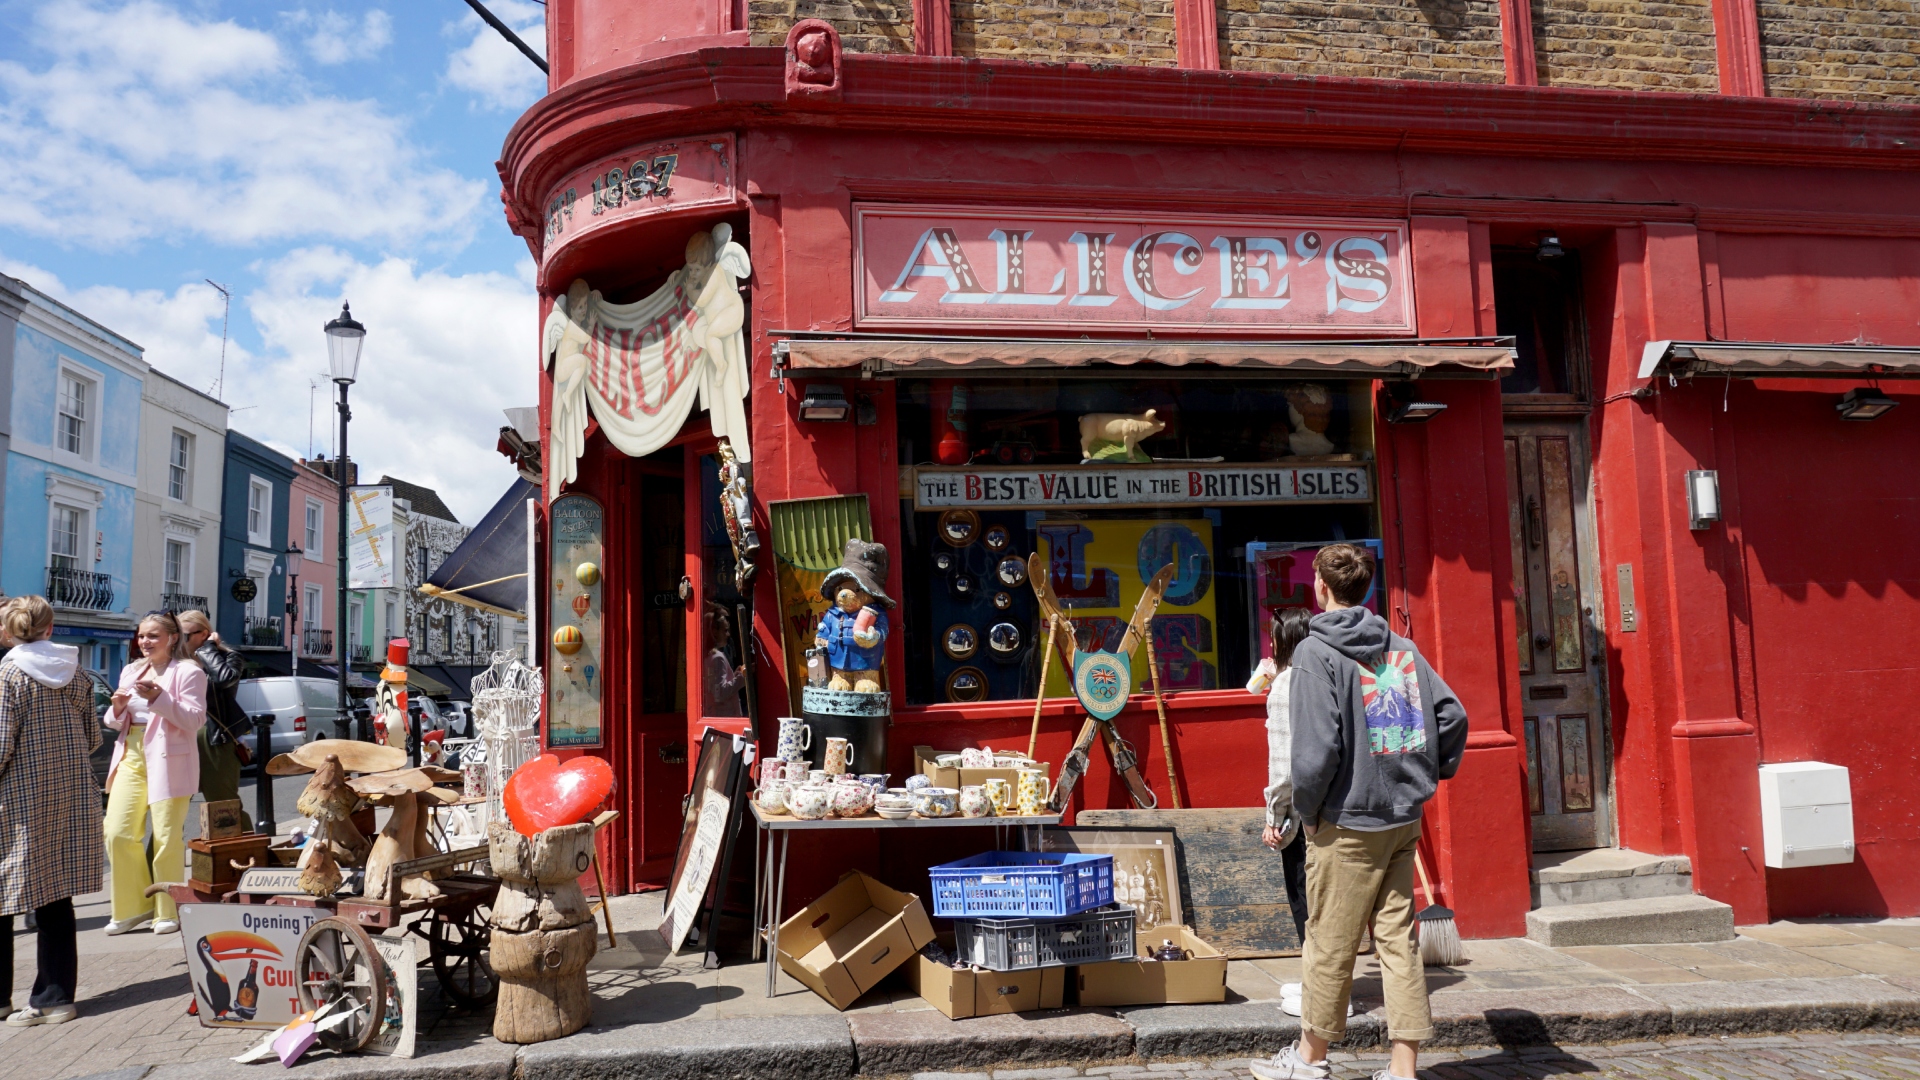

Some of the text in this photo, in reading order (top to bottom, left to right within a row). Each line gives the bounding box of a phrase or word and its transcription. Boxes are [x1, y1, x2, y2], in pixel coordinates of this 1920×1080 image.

[590, 153, 680, 216] 1887
[878, 226, 1395, 316] ALICE'S
[924, 469, 1360, 500] THE BEST VALUE IN THE BRITISH ISLES
[567, 500, 592, 508] GRAND
[555, 510, 600, 519] BALLOON
[560, 519, 595, 533] ASCENT
[1086, 698, 1121, 710] OSLO 1952
[568, 736, 582, 744] MAY
[242, 912, 300, 936] Opening
